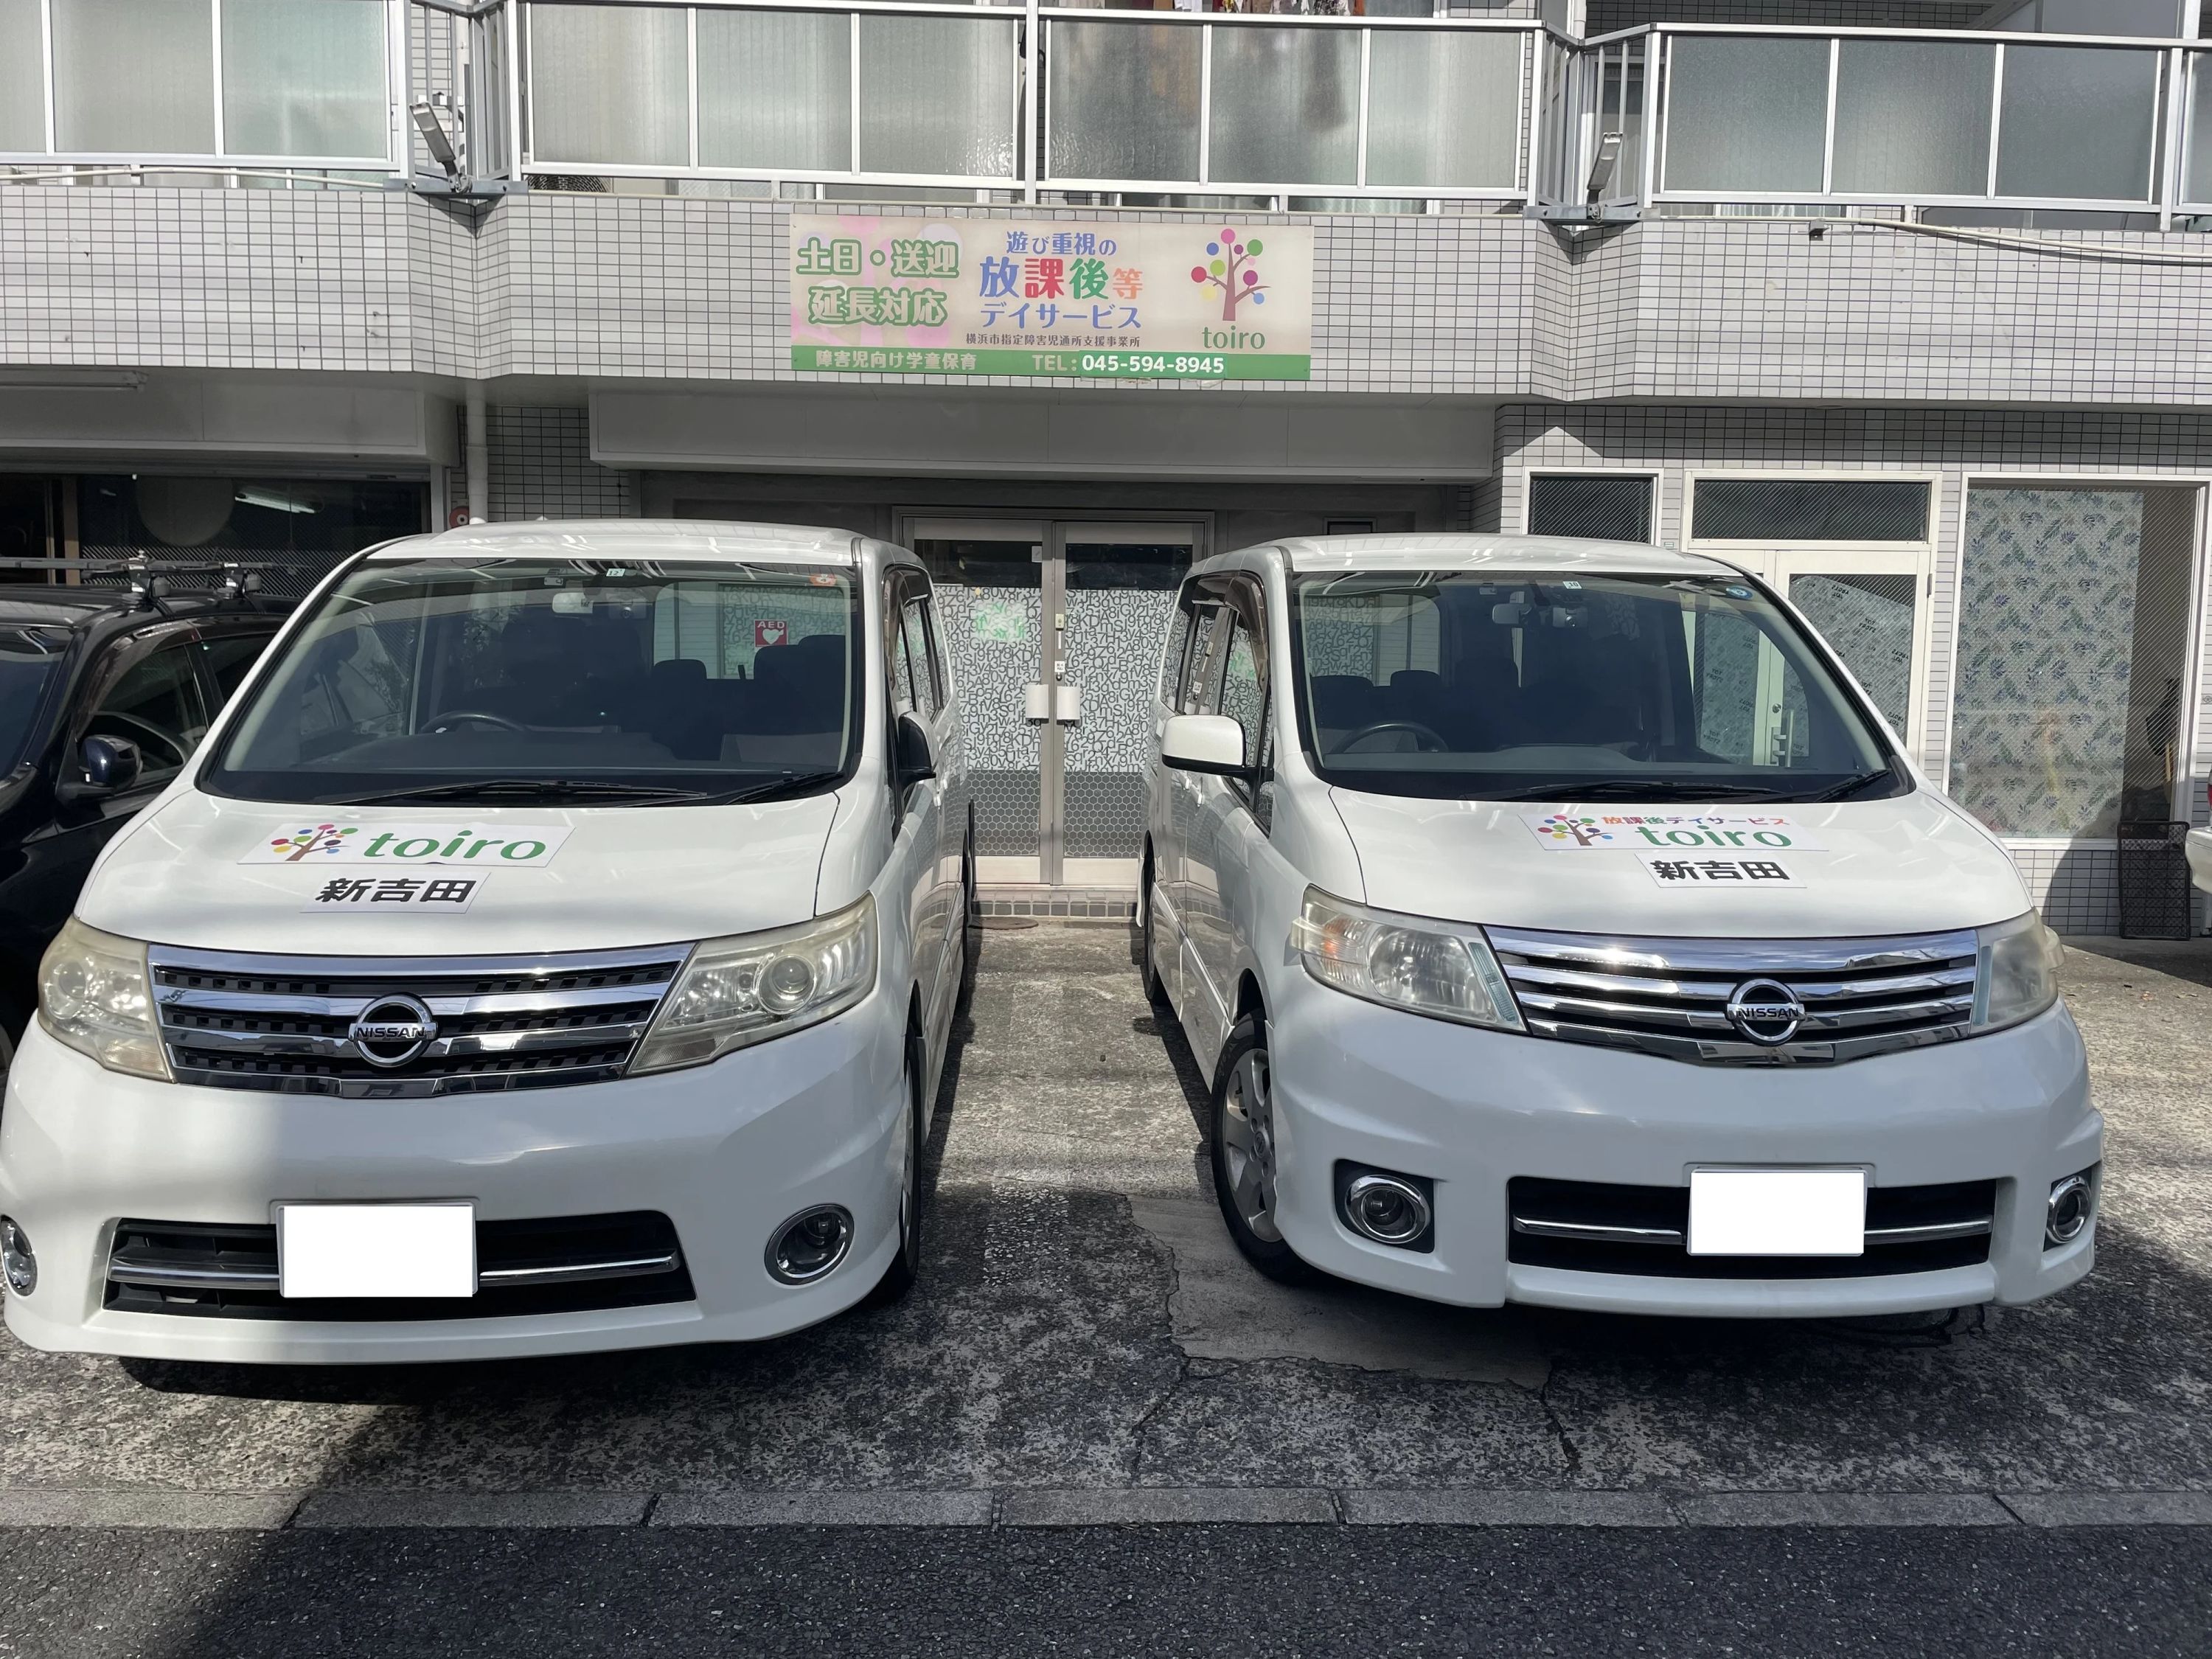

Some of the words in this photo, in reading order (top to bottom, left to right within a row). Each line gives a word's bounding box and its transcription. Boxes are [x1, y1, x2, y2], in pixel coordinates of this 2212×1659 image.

[1006, 231, 1117, 256] 遊び重視の
[796, 237, 960, 279] 土日・送迎
[979, 257, 1144, 299] 放課後等
[808, 286, 948, 327] 延長対応
[980, 302, 1141, 329] デイサービス
[966, 333, 1141, 347] 横浜市指定障害児通所支援事業所
[1202, 325, 1265, 349] toiro
[815, 349, 977, 371] 障害児向け学童保育
[1082, 355, 1224, 374] 045-594-8945
[757, 621, 785, 629] AED
[1601, 816, 1790, 826] 放課後デイサービス
[364, 830, 546, 860] toiro
[1634, 825, 1792, 846] toiro
[1650, 860, 1791, 880] 新吉田
[315, 877, 478, 903] 新吉田
[1738, 1008, 1799, 1018] NISSAN
[357, 1026, 425, 1038] NISSAN
